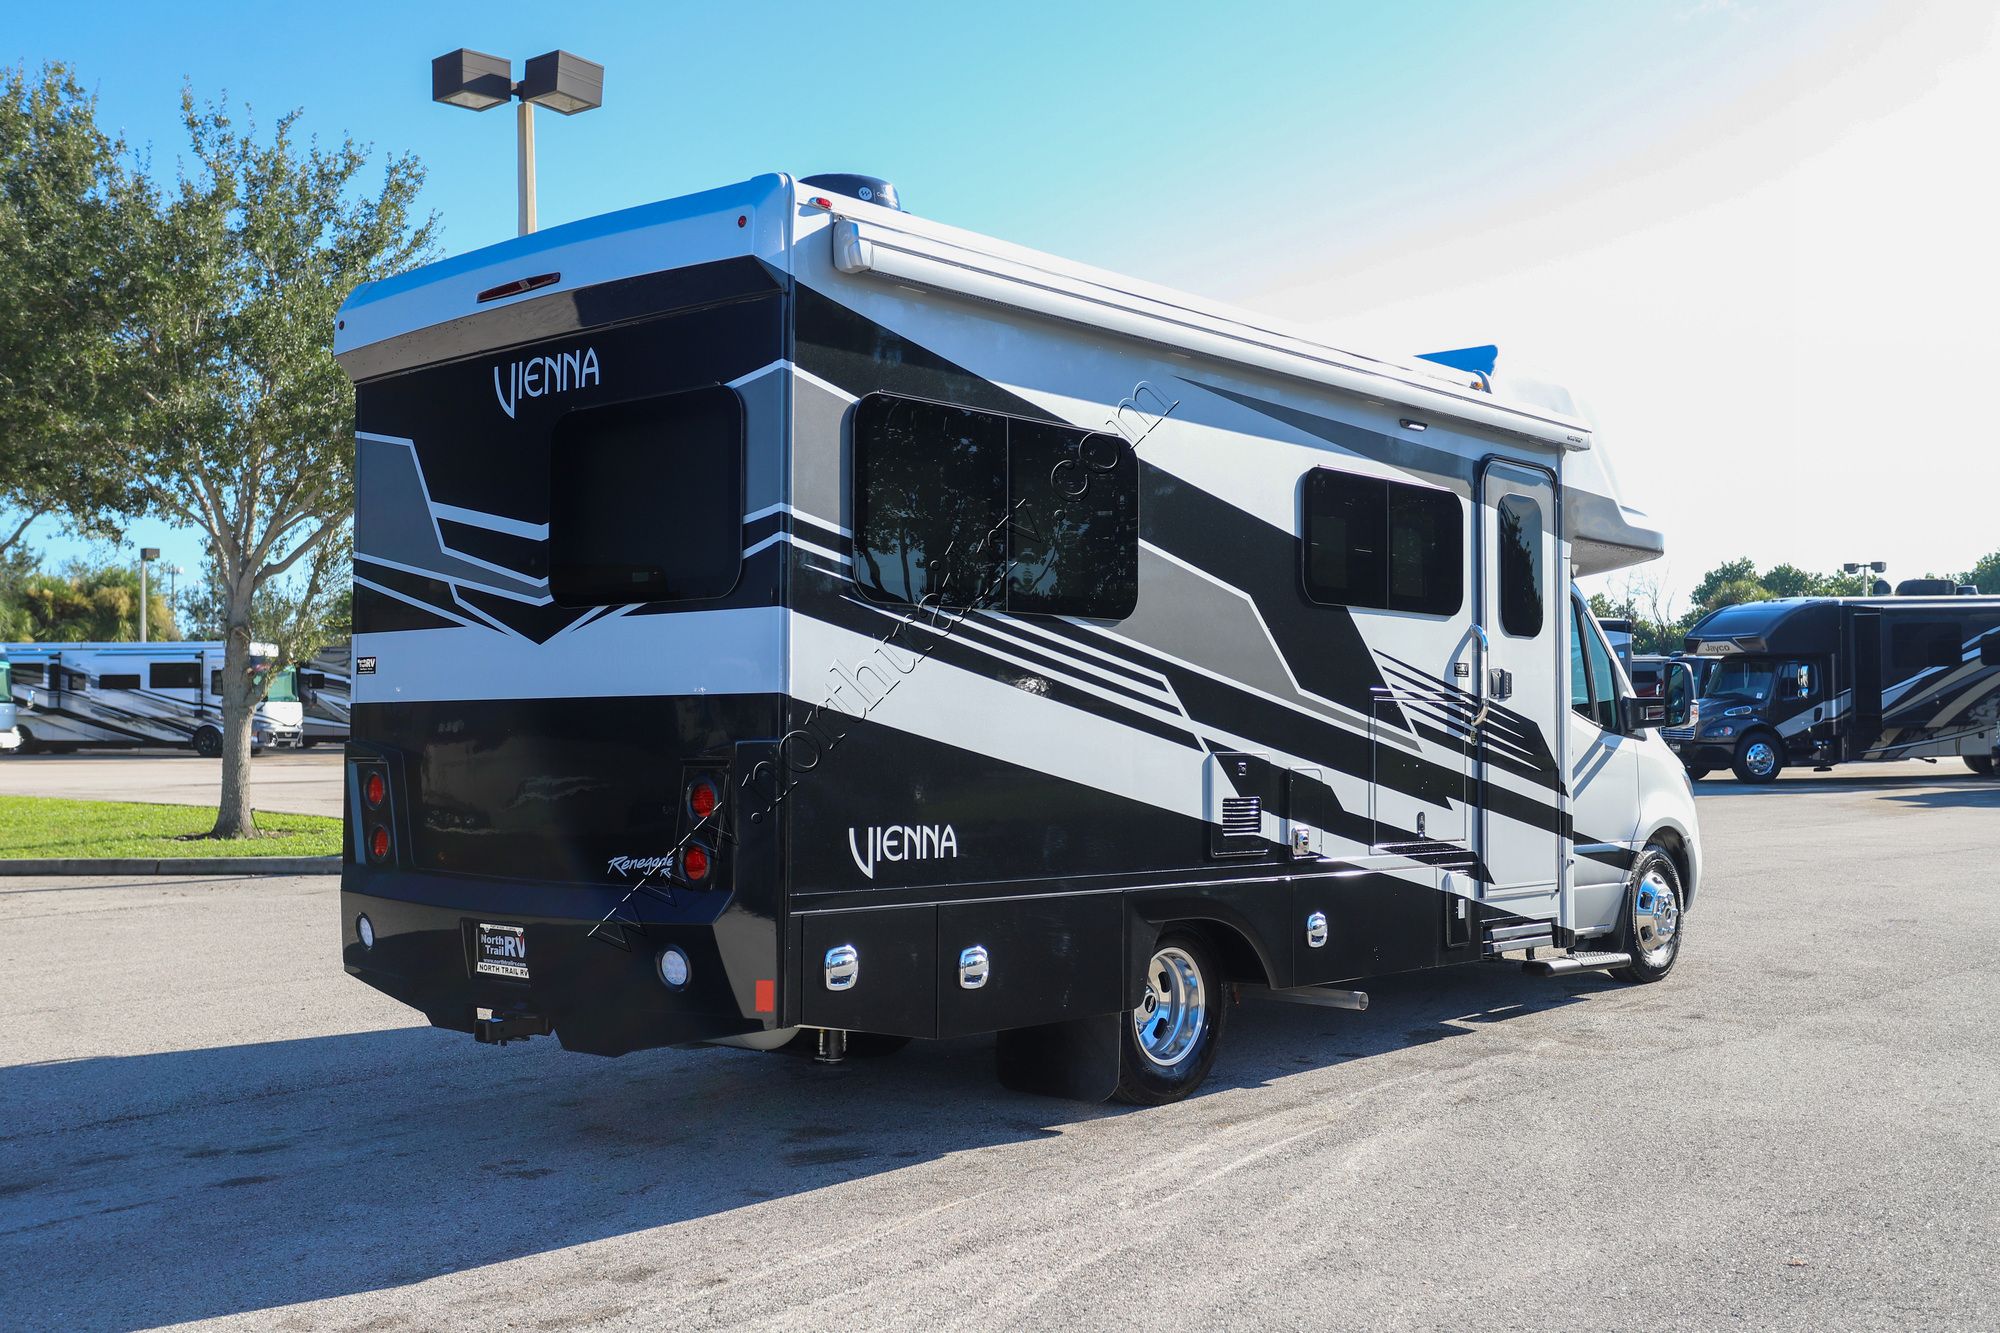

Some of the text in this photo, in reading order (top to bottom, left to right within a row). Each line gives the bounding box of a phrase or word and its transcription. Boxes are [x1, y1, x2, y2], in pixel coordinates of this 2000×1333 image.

[494, 347, 600, 419] VIENNA
[1705, 644, 1730, 653] Jayco
[848, 824, 958, 880] VIENNA
[607, 851, 674, 877] Renegade
[480, 934, 504, 945] North
[504, 936, 525, 958] RV
[485, 945, 504, 956] Trail
[479, 964, 529, 977] NORTH TRAIL RV
